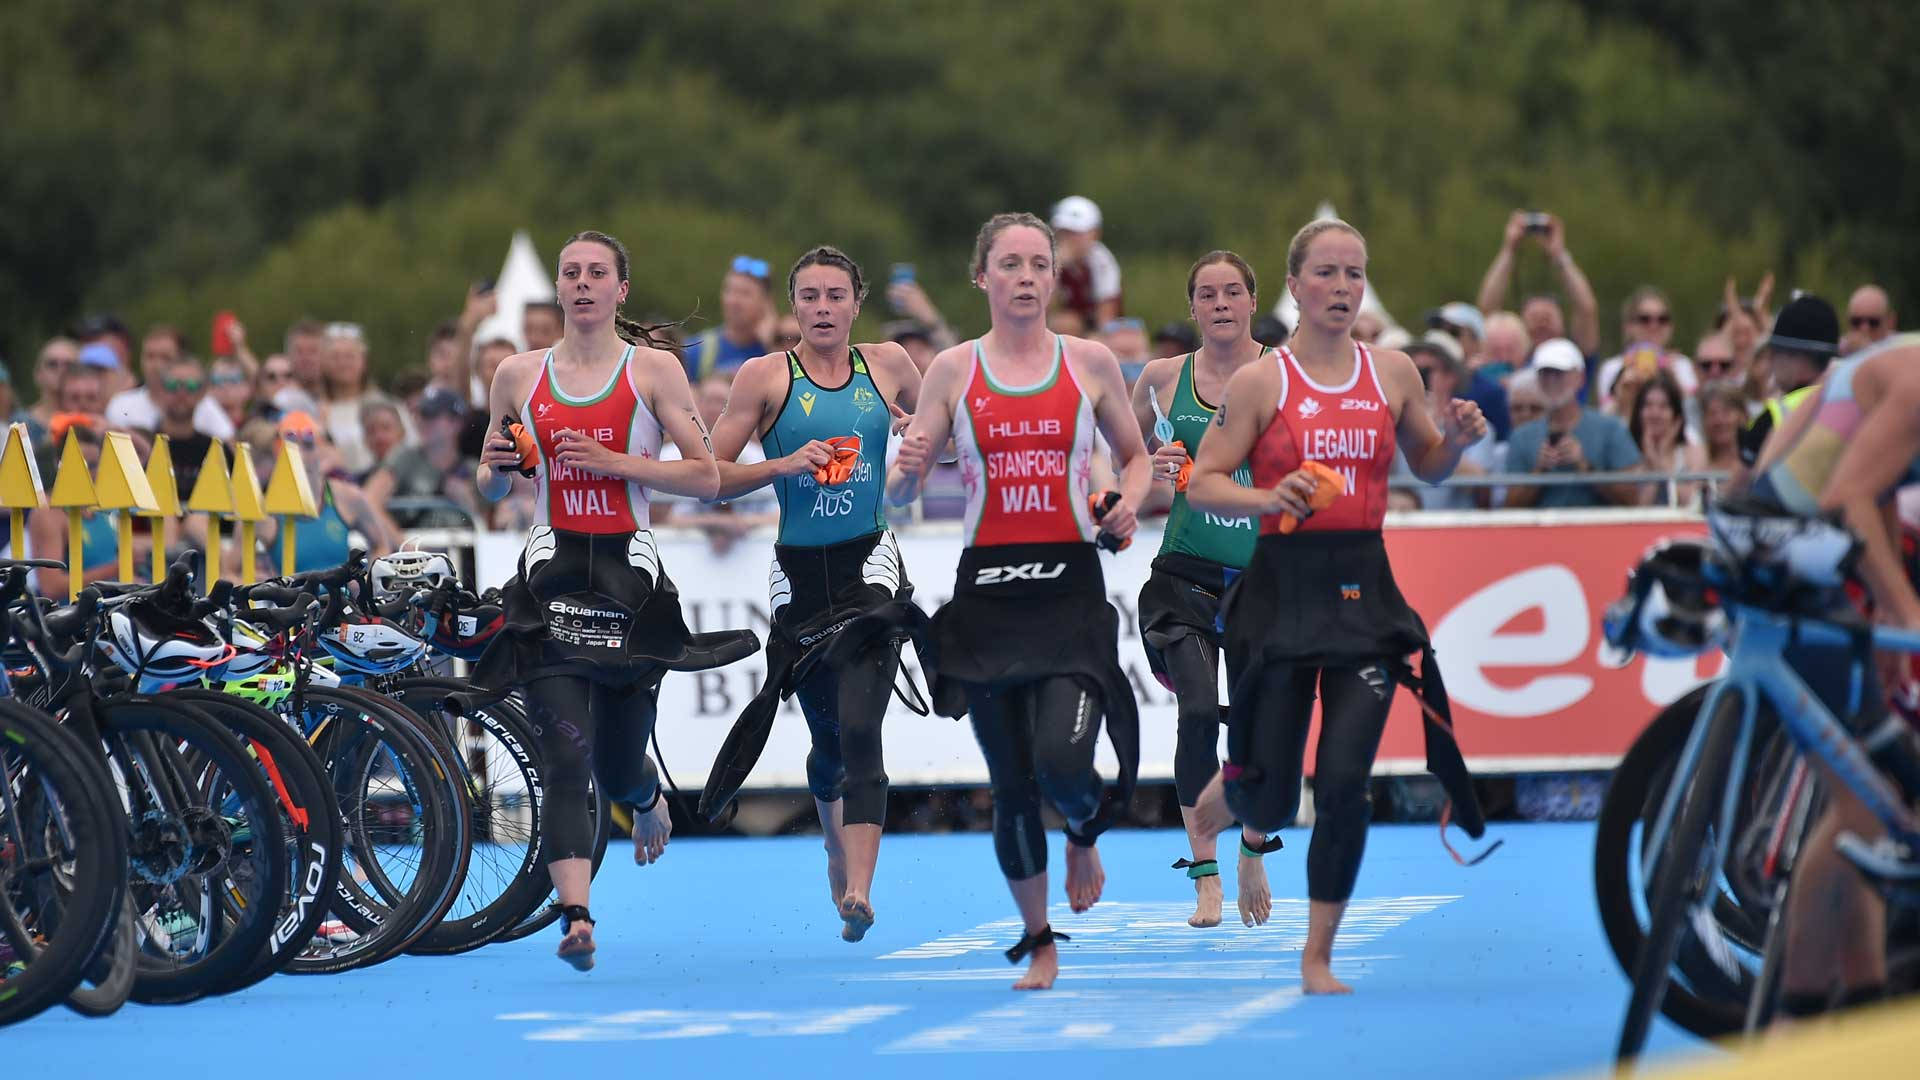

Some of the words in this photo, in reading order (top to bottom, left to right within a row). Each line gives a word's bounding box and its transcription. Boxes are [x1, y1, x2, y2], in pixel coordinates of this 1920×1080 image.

[1340, 398, 1379, 411] 2XU
[988, 419, 1061, 438] HUUB
[1177, 415, 1209, 423] orca
[1304, 428, 1378, 460] LEGAULT
[988, 449, 1066, 479] STANFORD
[562, 489, 617, 516] WAL
[810, 489, 854, 518] AUS
[1001, 484, 1058, 513] WAL
[975, 562, 1067, 586] 2XU
[555, 615, 620, 630] GOLD
[353, 631, 365, 643] 28
[269, 842, 325, 955] roval
